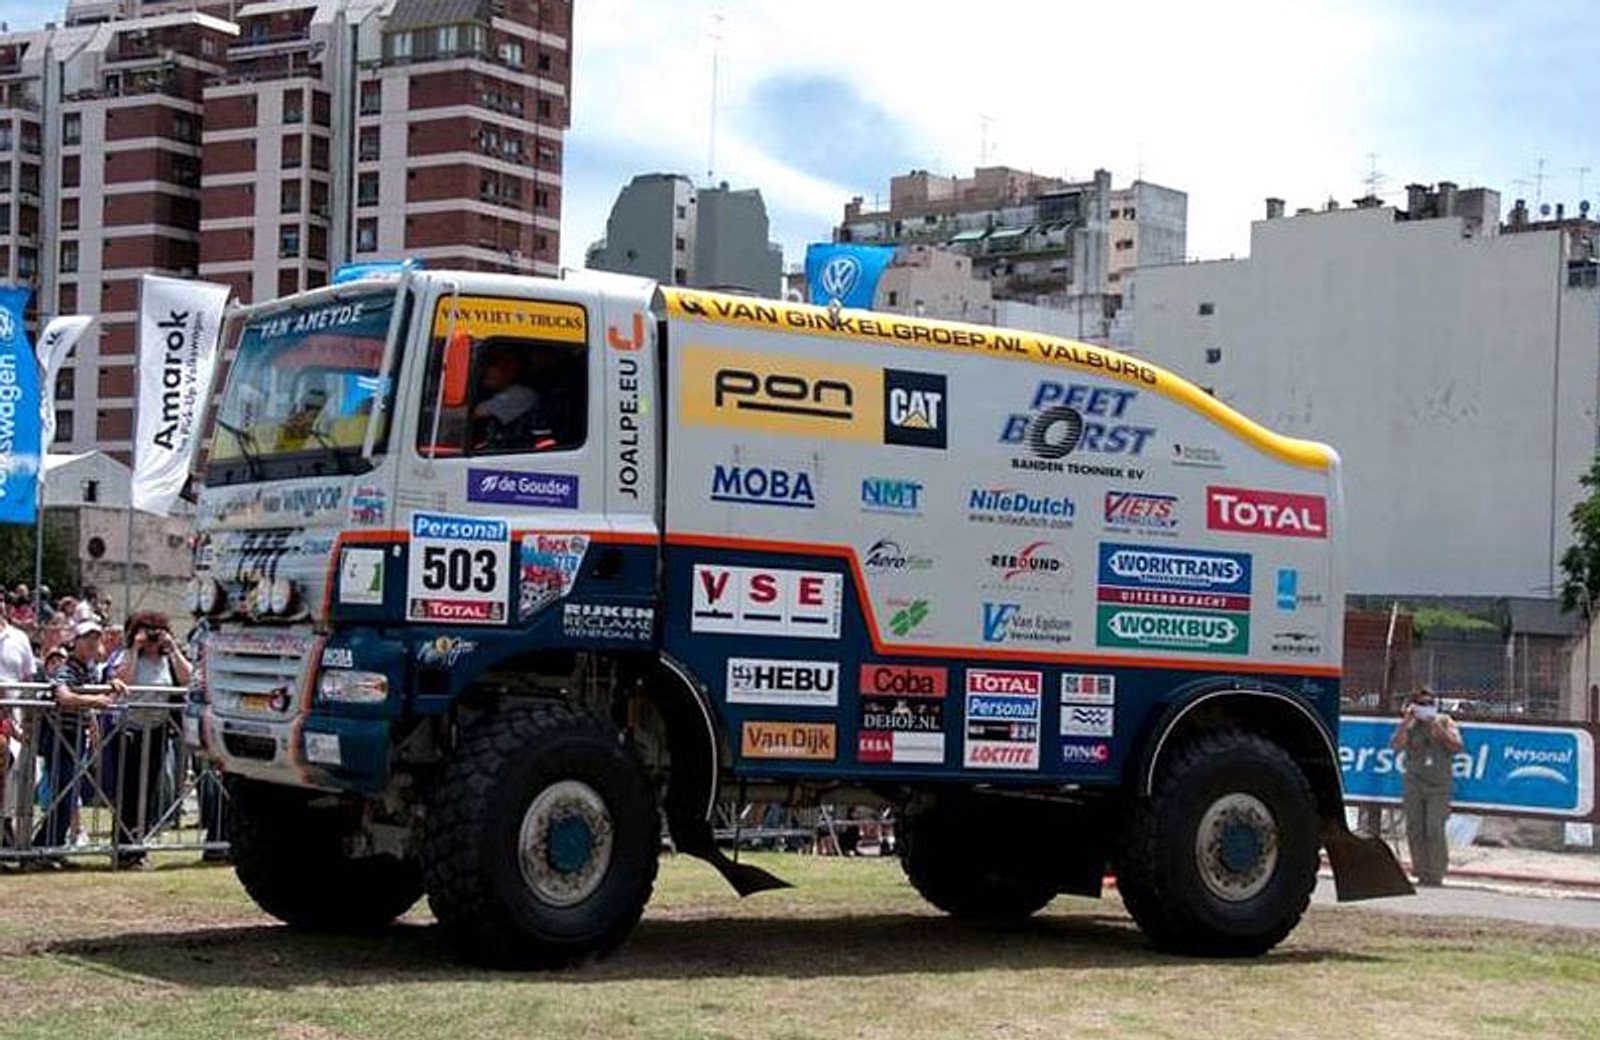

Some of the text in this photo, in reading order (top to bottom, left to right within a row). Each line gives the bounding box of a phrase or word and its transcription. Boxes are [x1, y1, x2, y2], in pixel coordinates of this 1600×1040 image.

[530, 314, 583, 330] TRUCKS
[713, 299, 1157, 385] VAN GINKELGROEP.NL VALBURG
[153, 310, 189, 450] Amarok
[714, 369, 853, 407] pon
[890, 388, 941, 428] CAT
[1030, 380, 1140, 418] PEET
[619, 358, 638, 499] JOALPE.EU
[998, 406, 1157, 459] BORST
[498, 476, 570, 496] de Goudse
[712, 465, 814, 500] MOBA
[862, 478, 923, 509] NMT
[969, 489, 1075, 517] NileDutch
[1212, 494, 1322, 531] TOTAL
[414, 516, 505, 540] Personal
[423, 546, 497, 592] 503
[1116, 554, 1234, 579] WORKTRANS
[429, 602, 487, 618] TOTAL
[1119, 615, 1229, 639] WORKBUS
[754, 666, 834, 691] HEBU
[873, 667, 935, 694] Coba
[970, 673, 1036, 693] TOTAL
[969, 697, 1036, 717] Personal
[747, 727, 830, 755] Van Dijk
[1503, 745, 1573, 764] Personal
[1338, 743, 1489, 779] ersal
